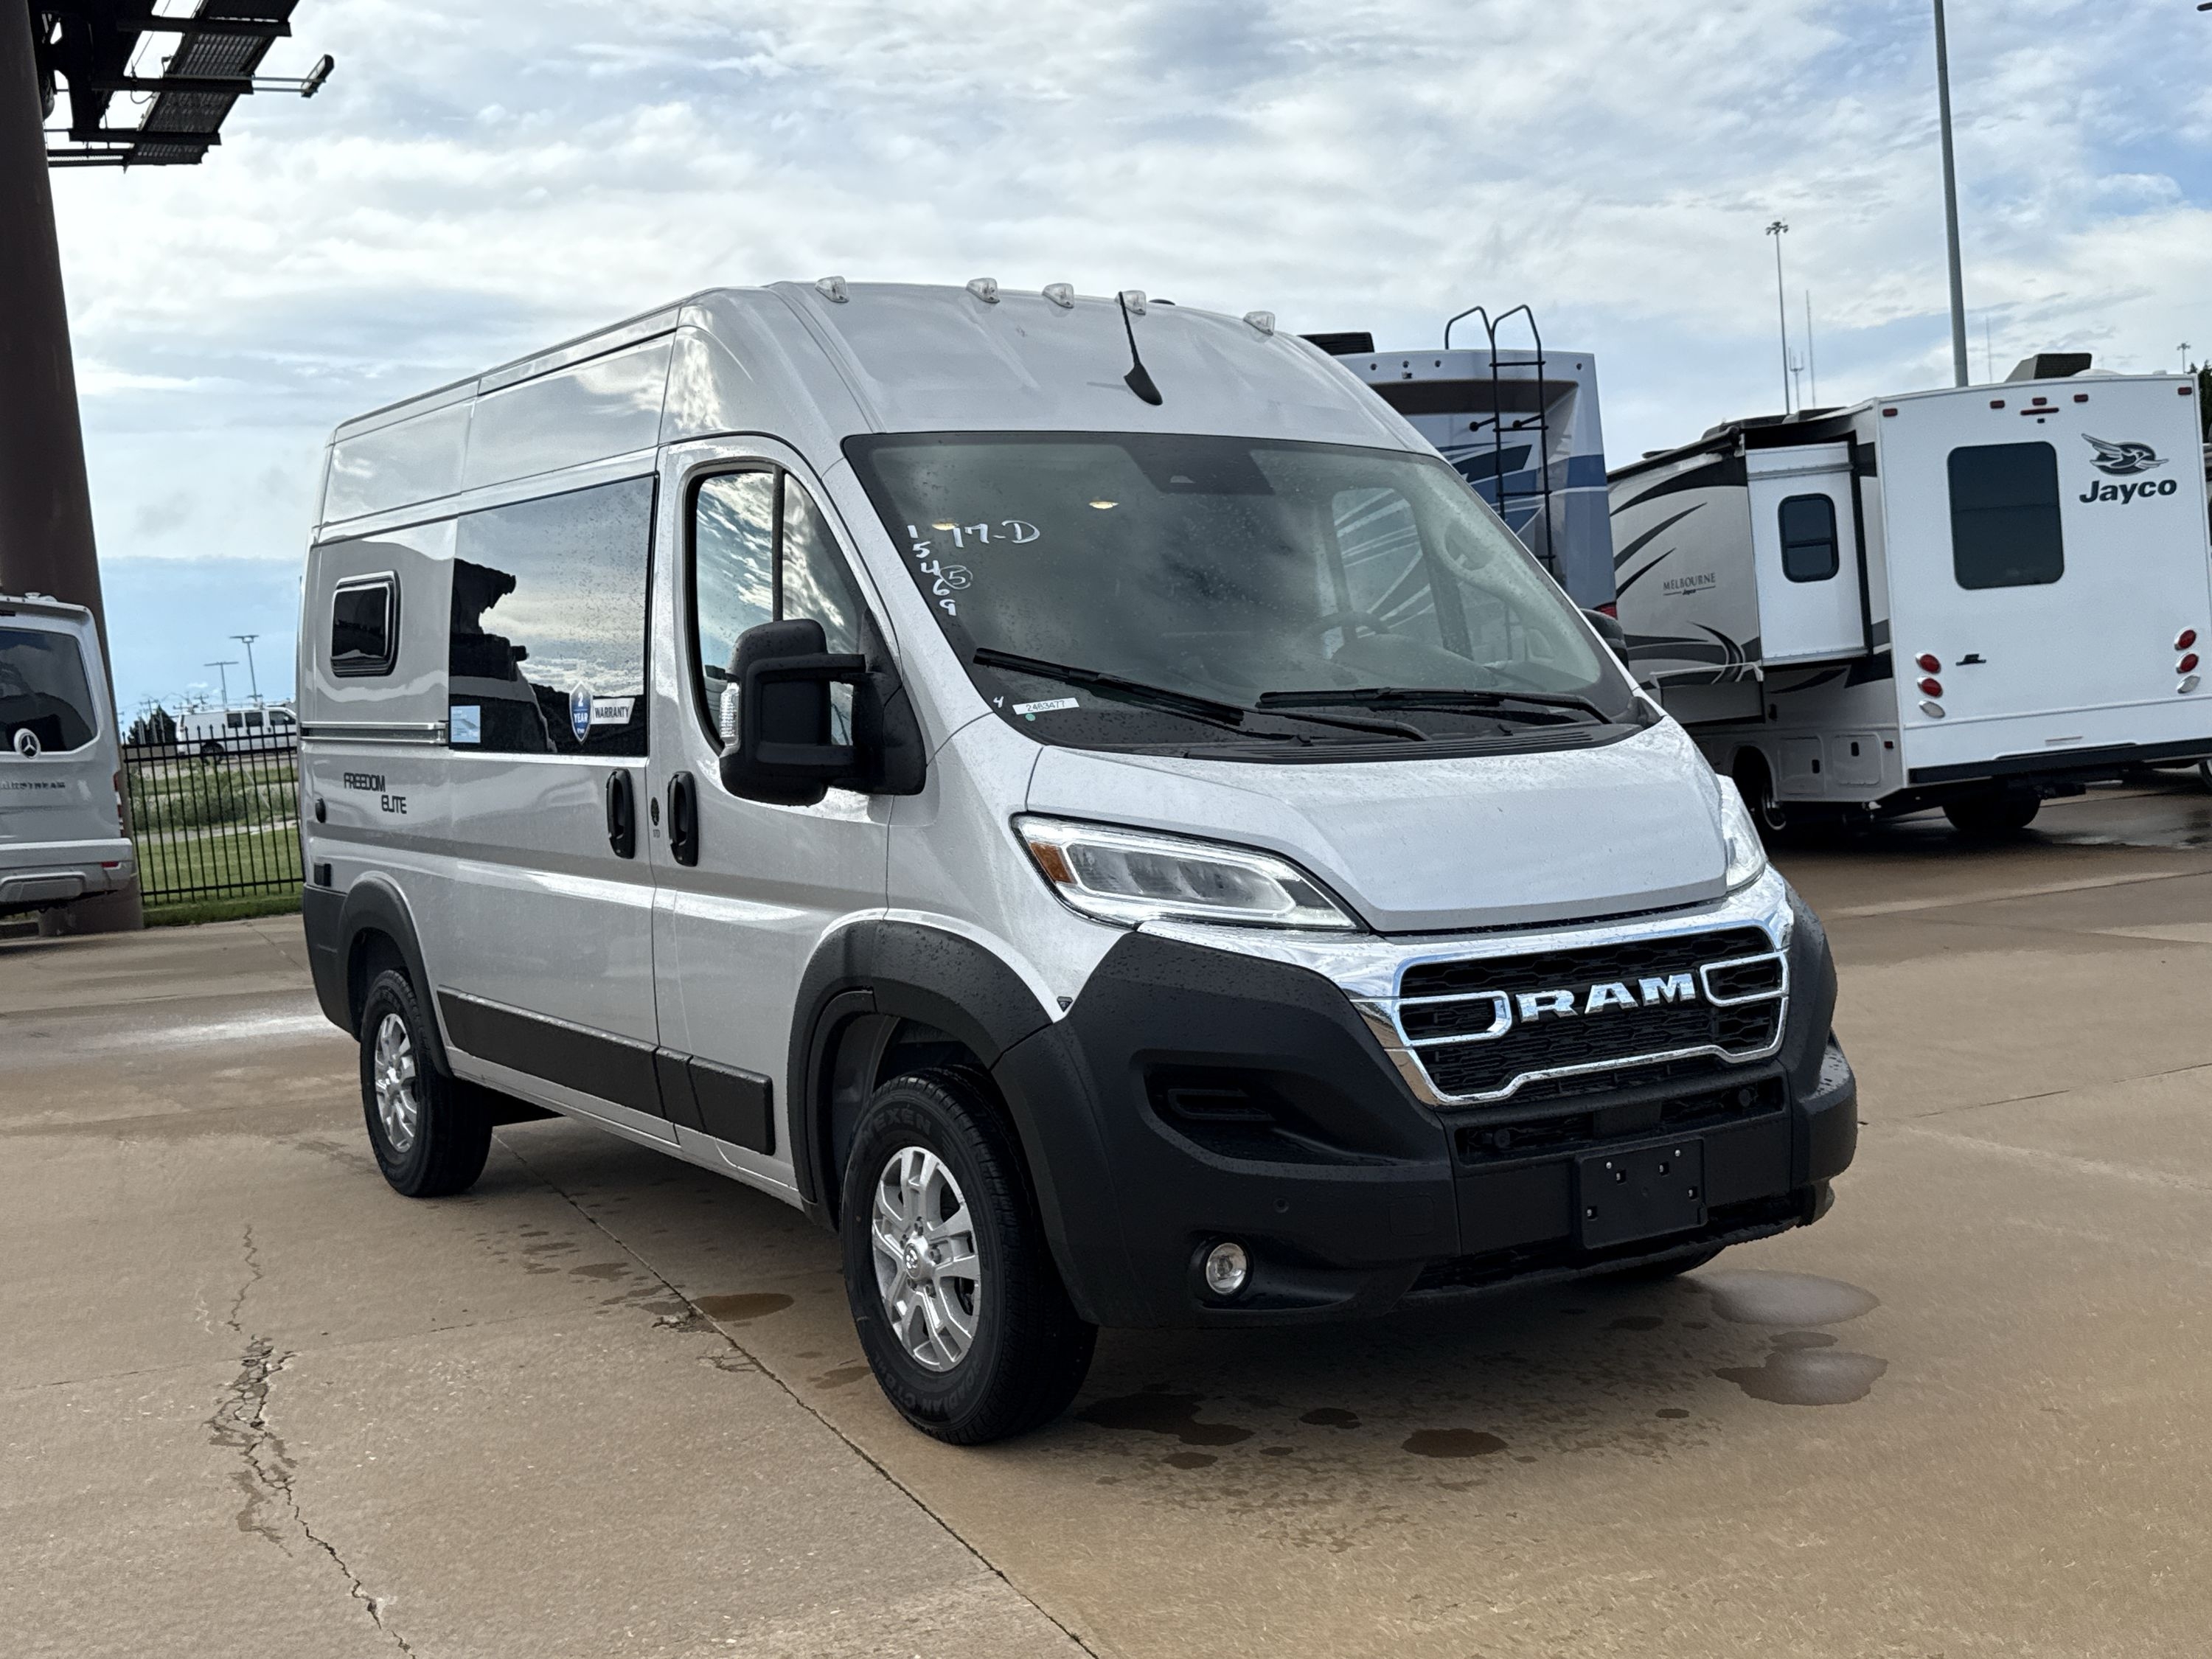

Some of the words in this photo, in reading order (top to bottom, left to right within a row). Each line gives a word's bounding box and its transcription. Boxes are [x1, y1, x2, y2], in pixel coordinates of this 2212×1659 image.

[2079, 479, 2177, 505] Jayco
[1663, 573, 1716, 590] MELBOURNE
[577, 692, 584, 707] 2
[574, 712, 588, 723] YEAR
[594, 706, 629, 719] WARRANTY
[344, 772, 386, 793] FREEDOM
[381, 794, 407, 814] ELITE
[1516, 973, 1696, 1023] RAM
